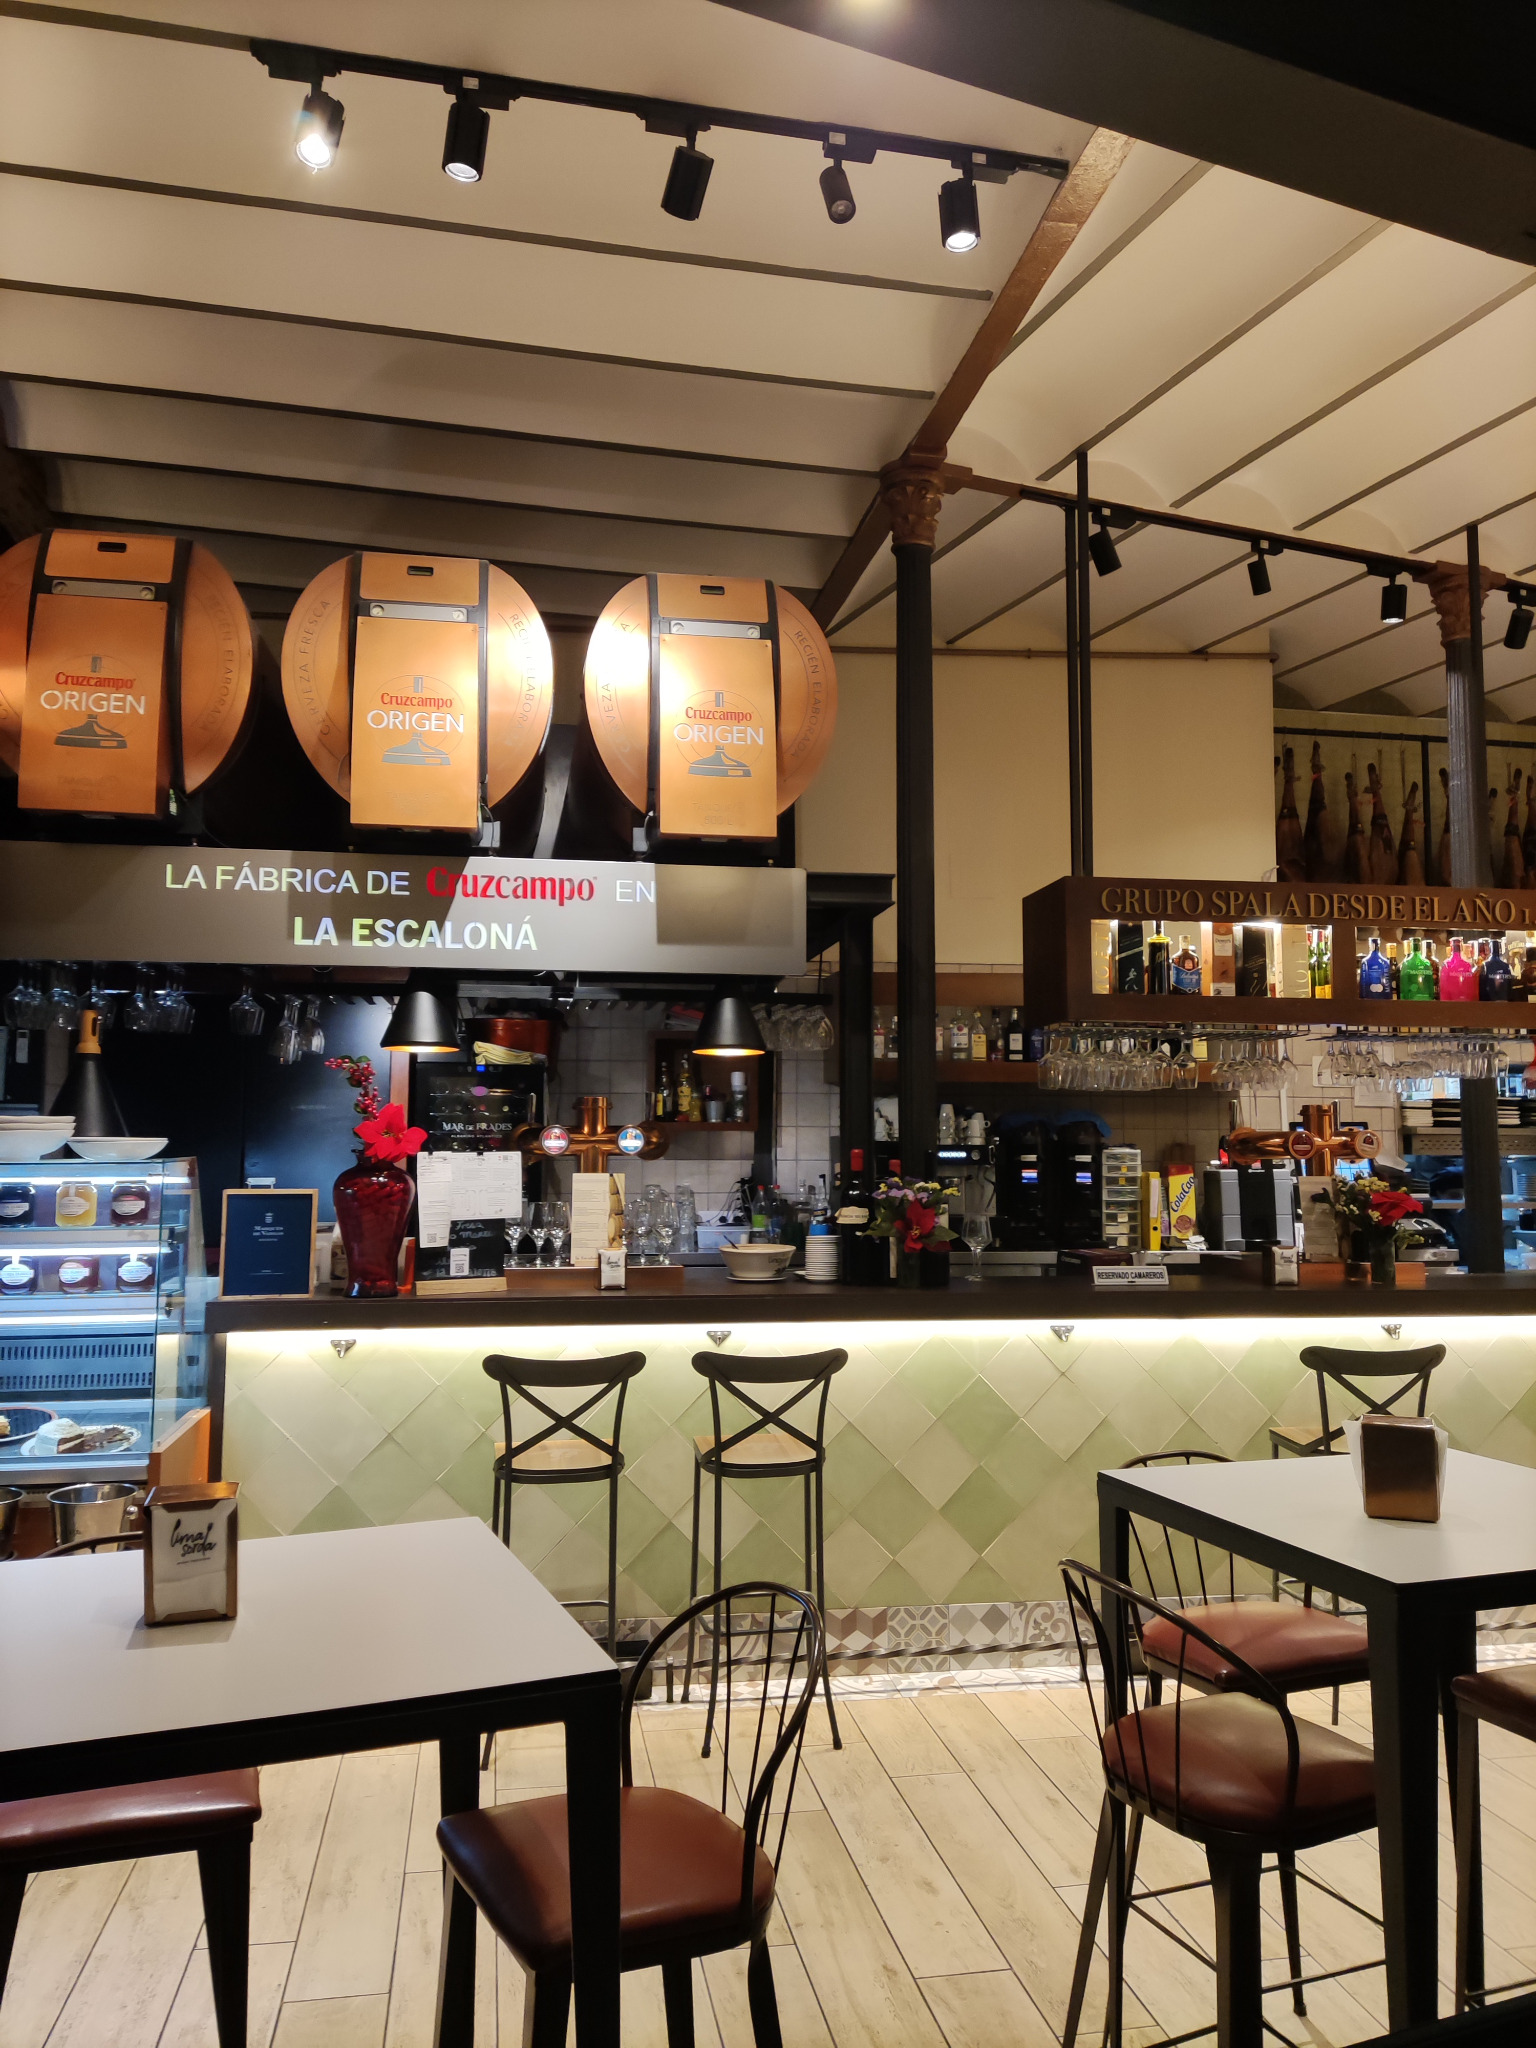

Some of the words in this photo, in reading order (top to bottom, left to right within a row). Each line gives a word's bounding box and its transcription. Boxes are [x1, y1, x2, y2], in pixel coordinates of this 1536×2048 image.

[55, 671, 135, 690] Cruzcampo
[40, 690, 146, 715] ORIGEN
[380, 692, 453, 710] Cruzcampo
[366, 709, 464, 733] ORIGEN
[685, 706, 753, 723] Cruzcampo
[673, 723, 764, 745] ORIGEN
[166, 864, 207, 889] LA
[215, 861, 359, 894] FÁBRICA
[367, 870, 410, 895] DE
[426, 866, 596, 906] Cruzcampo
[615, 879, 656, 903] EN
[1101, 887, 1204, 916] GRUPO
[1211, 890, 1303, 918] SPALA
[1308, 892, 1407, 921] DESDE
[1412, 896, 1449, 922] EL
[1453, 892, 1516, 924] AÑO
[293, 916, 339, 946] LA
[352, 915, 538, 950] ESCALONÁ
[442, 1121, 464, 1131] MAR
[476, 1122, 513, 1132] FRADES
[1170, 1176, 1196, 1213] ColaCao
[1097, 1271, 1130, 1279] RESERVADO
[1130, 1271, 1164, 1279] CAMAREROS
